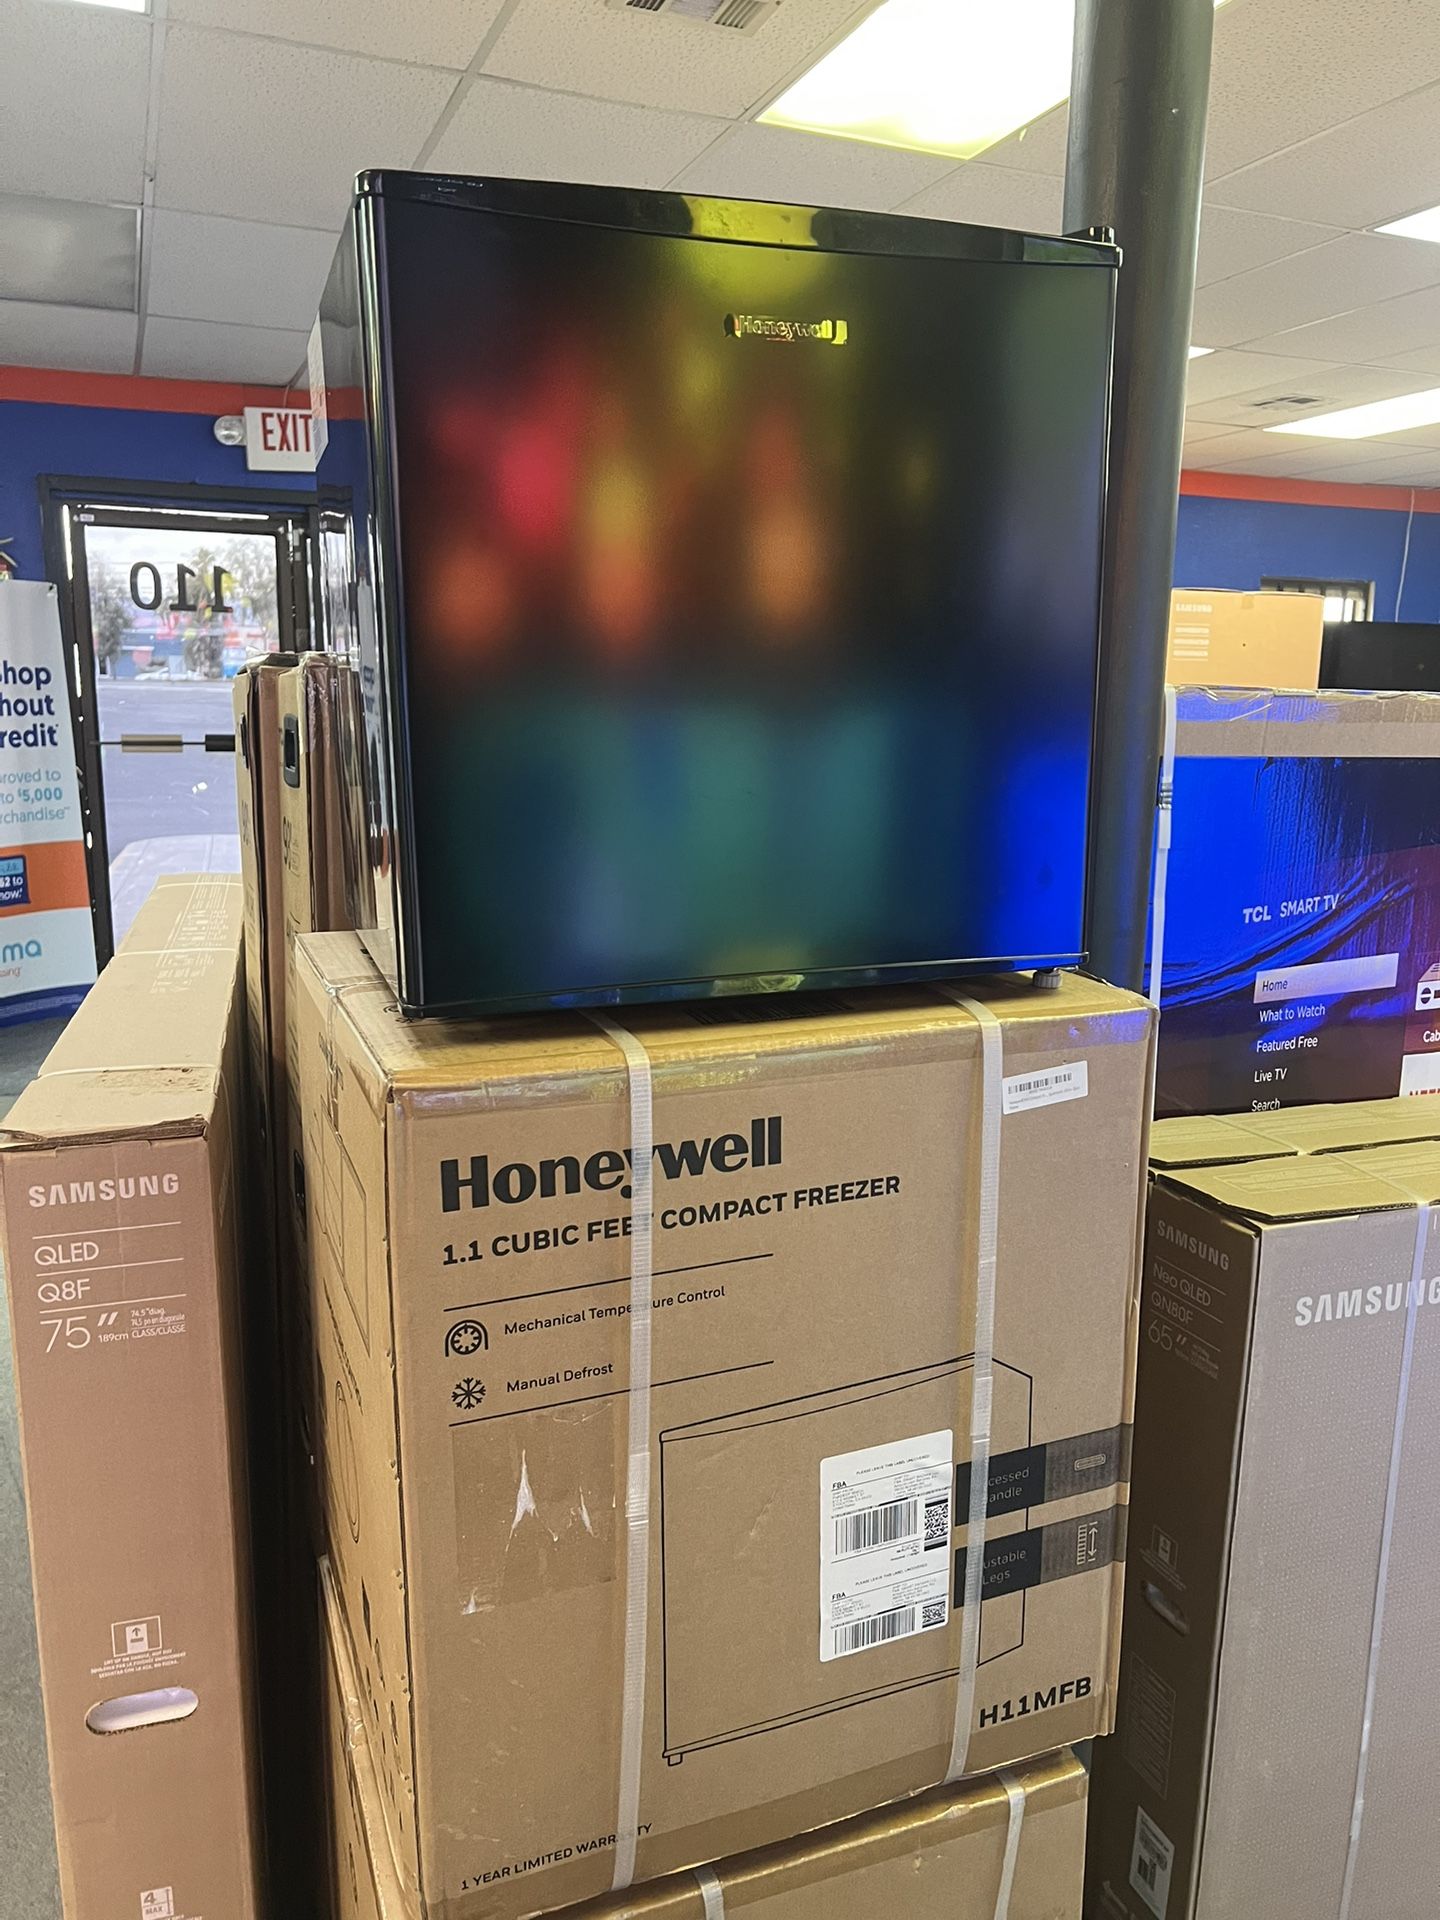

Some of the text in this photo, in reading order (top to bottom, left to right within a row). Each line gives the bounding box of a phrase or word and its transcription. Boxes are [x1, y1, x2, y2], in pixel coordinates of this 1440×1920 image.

[261, 412, 313, 453] EXIT
[45, 769, 62, 782] to
[1243, 893, 1340, 923] TCL SMART TV
[1262, 978, 1289, 992] Home
[1259, 1003, 1326, 1023] What to Watch
[1256, 1035, 1319, 1053] Featured Free
[1253, 1067, 1288, 1083] Live TV
[1251, 1098, 1281, 1112] Search
[440, 1115, 783, 1213] Honeywell
[28, 1173, 181, 1208] SAMSUNG
[443, 1175, 901, 1266] 1.1 CUBIC FEE COMPACT FREEZER
[34, 1241, 100, 1266] QLED
[1156, 1219, 1230, 1271] SAMSUNG
[37, 1278, 91, 1304] Q8F
[1153, 1262, 1212, 1307] Neo QLED
[504, 1284, 726, 1337] Mechanical Tempeure Control
[98, 1331, 129, 1343] 189cm
[506, 1362, 614, 1395] Manual Defrost
[831, 1480, 847, 1490] FBA
[988, 1466, 1031, 1487] cessed
[988, 1485, 1024, 1504] andle
[983, 1549, 1028, 1570] ustable
[982, 1569, 1012, 1588] Legs
[831, 1591, 847, 1601] FBA
[979, 1676, 1093, 1728] H11MFB
[460, 1822, 653, 1891] 1 YEAR LIMITED WARRTY
